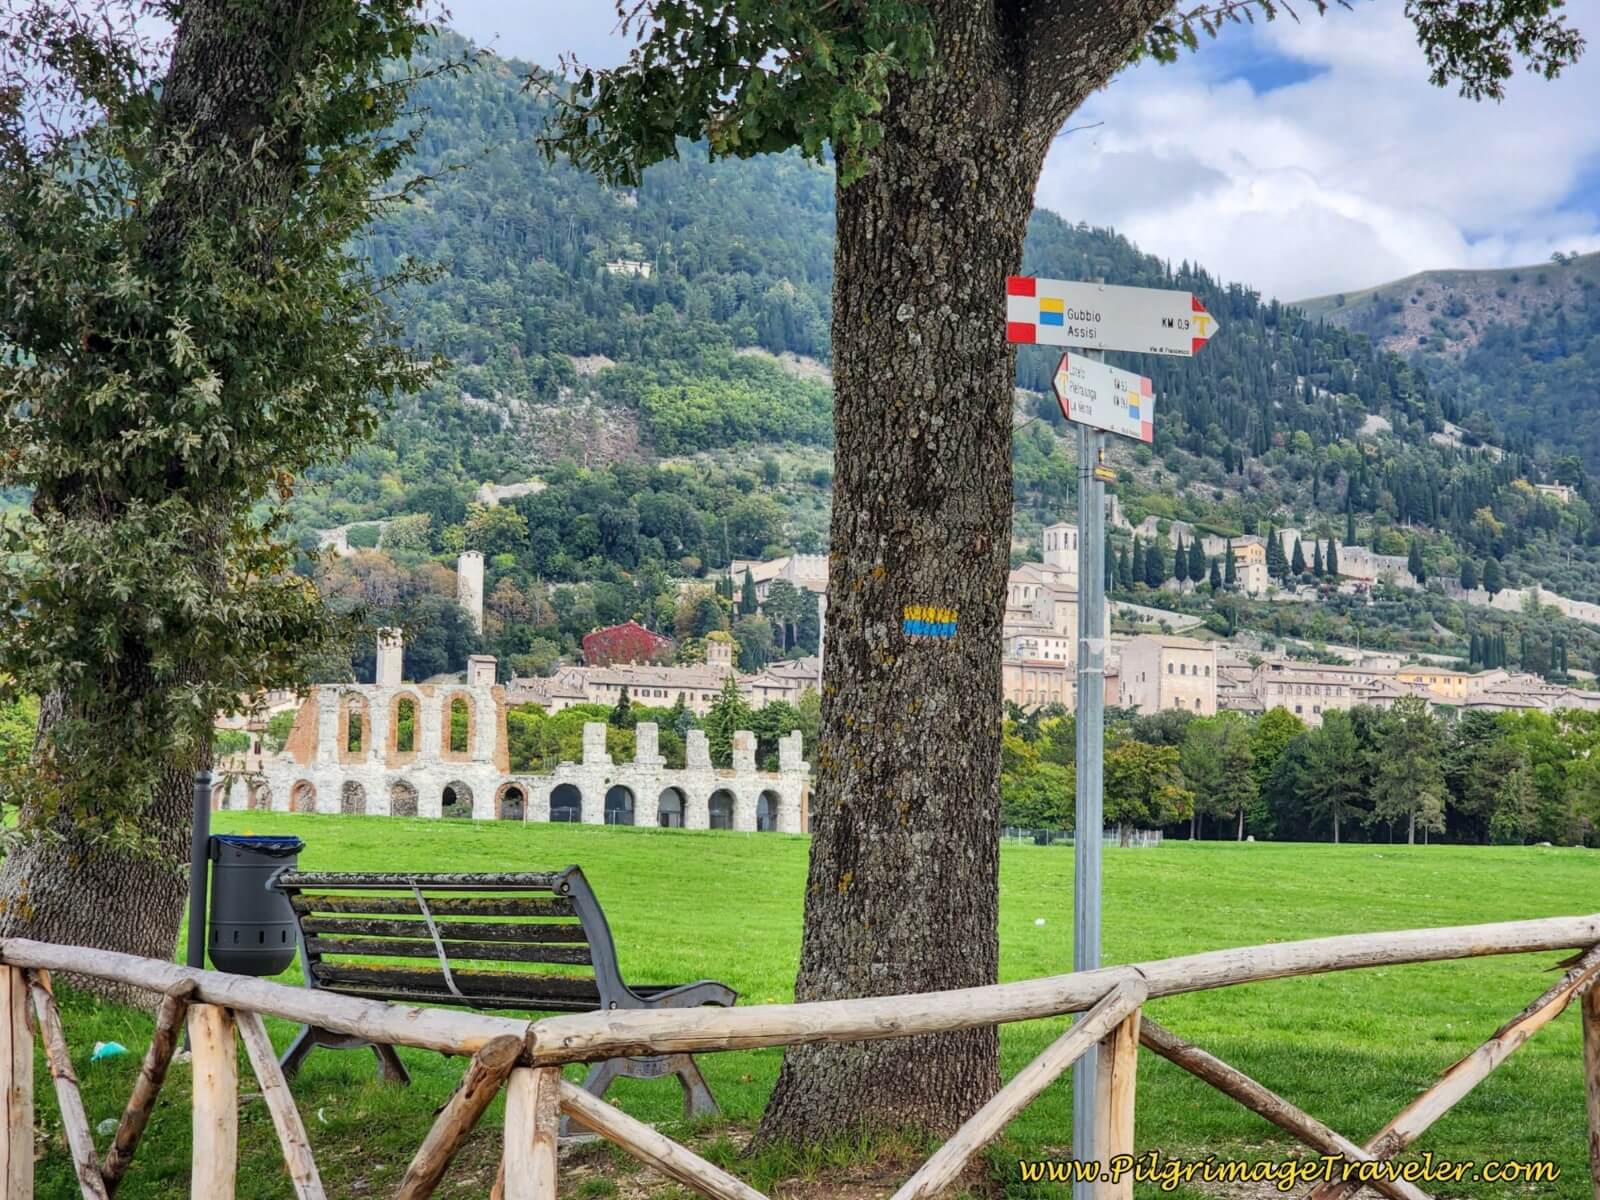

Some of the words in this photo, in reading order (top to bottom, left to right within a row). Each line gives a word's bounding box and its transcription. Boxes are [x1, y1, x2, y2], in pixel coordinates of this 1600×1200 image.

[1067, 307, 1101, 322] Gubbio
[1161, 317, 1174, 328] KM
[1067, 324, 1096, 339] Assisi
